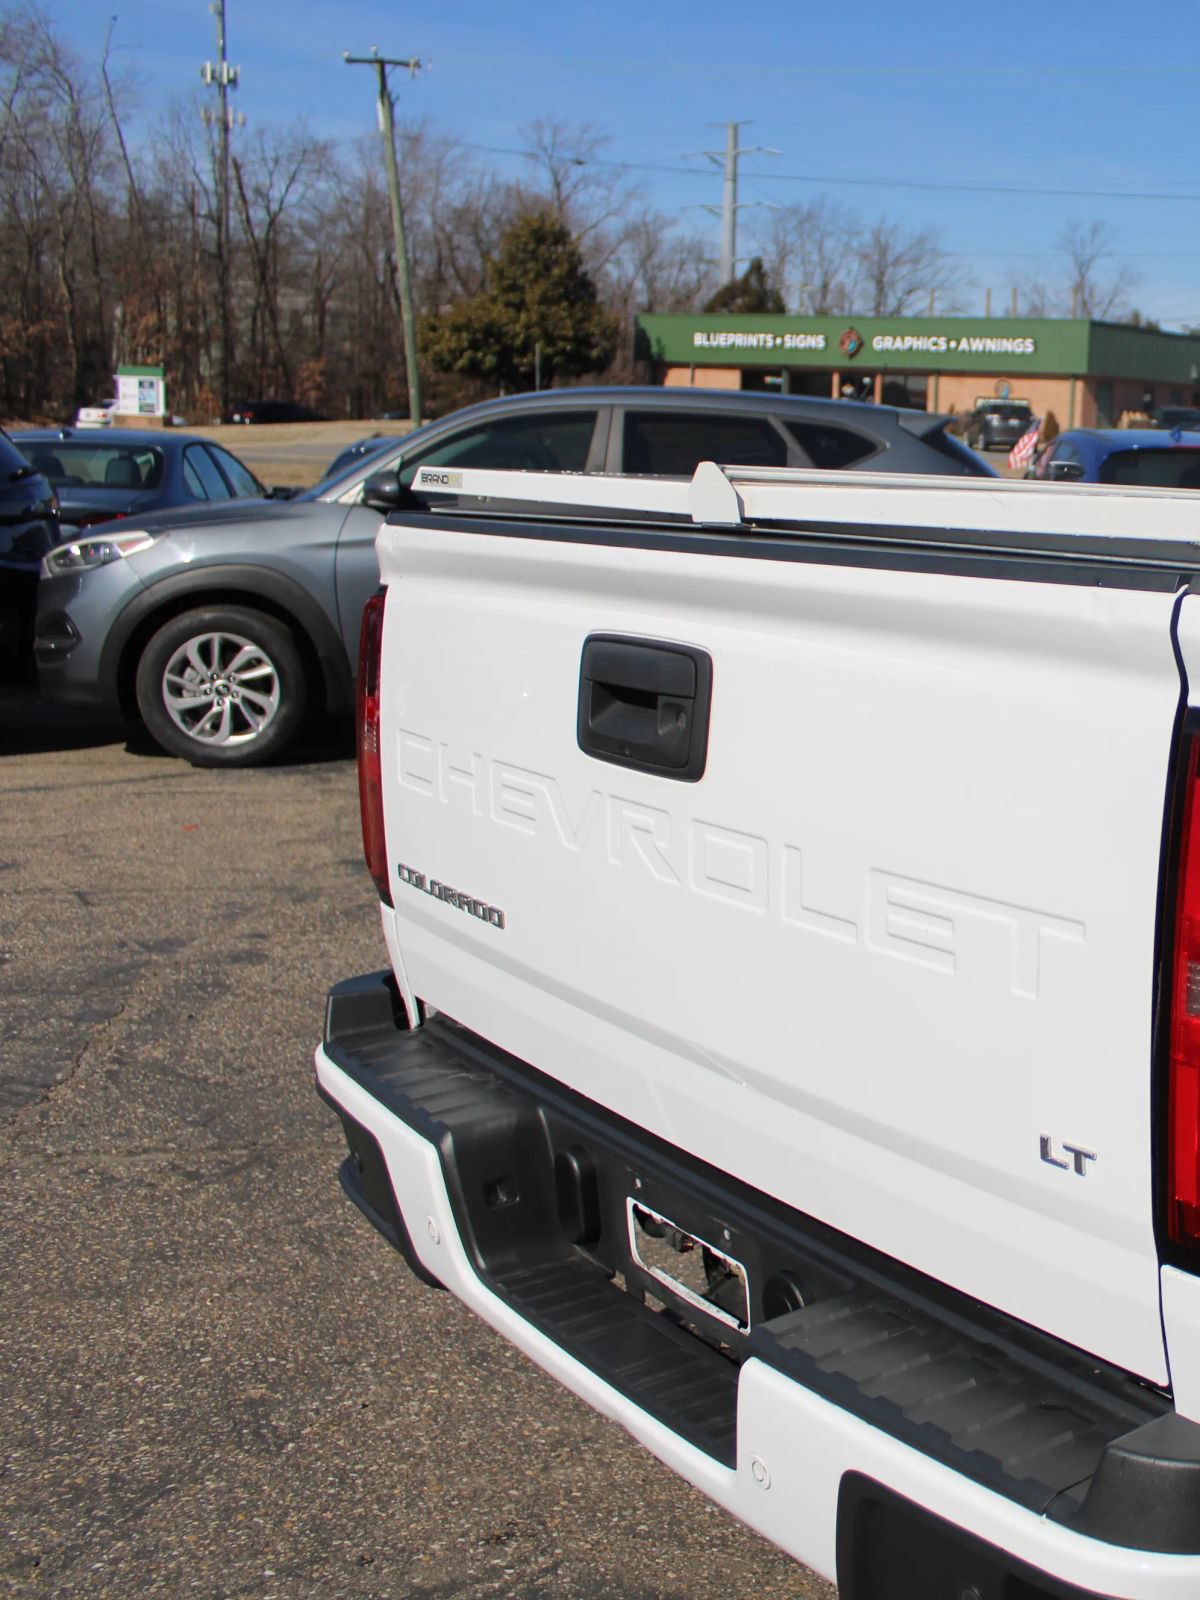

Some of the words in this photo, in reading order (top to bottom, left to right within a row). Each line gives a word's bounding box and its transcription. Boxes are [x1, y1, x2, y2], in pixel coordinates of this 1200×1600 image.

[693, 332, 774, 348] BLUEPRINTS
[783, 334, 826, 349] SIGNS
[872, 335, 948, 351] GRAPHICS
[957, 337, 1035, 353] AWNINGS
[396, 727, 1087, 1001] CHEVROLET
[397, 863, 505, 930] COLORADO
[1039, 1132, 1098, 1177] LT
